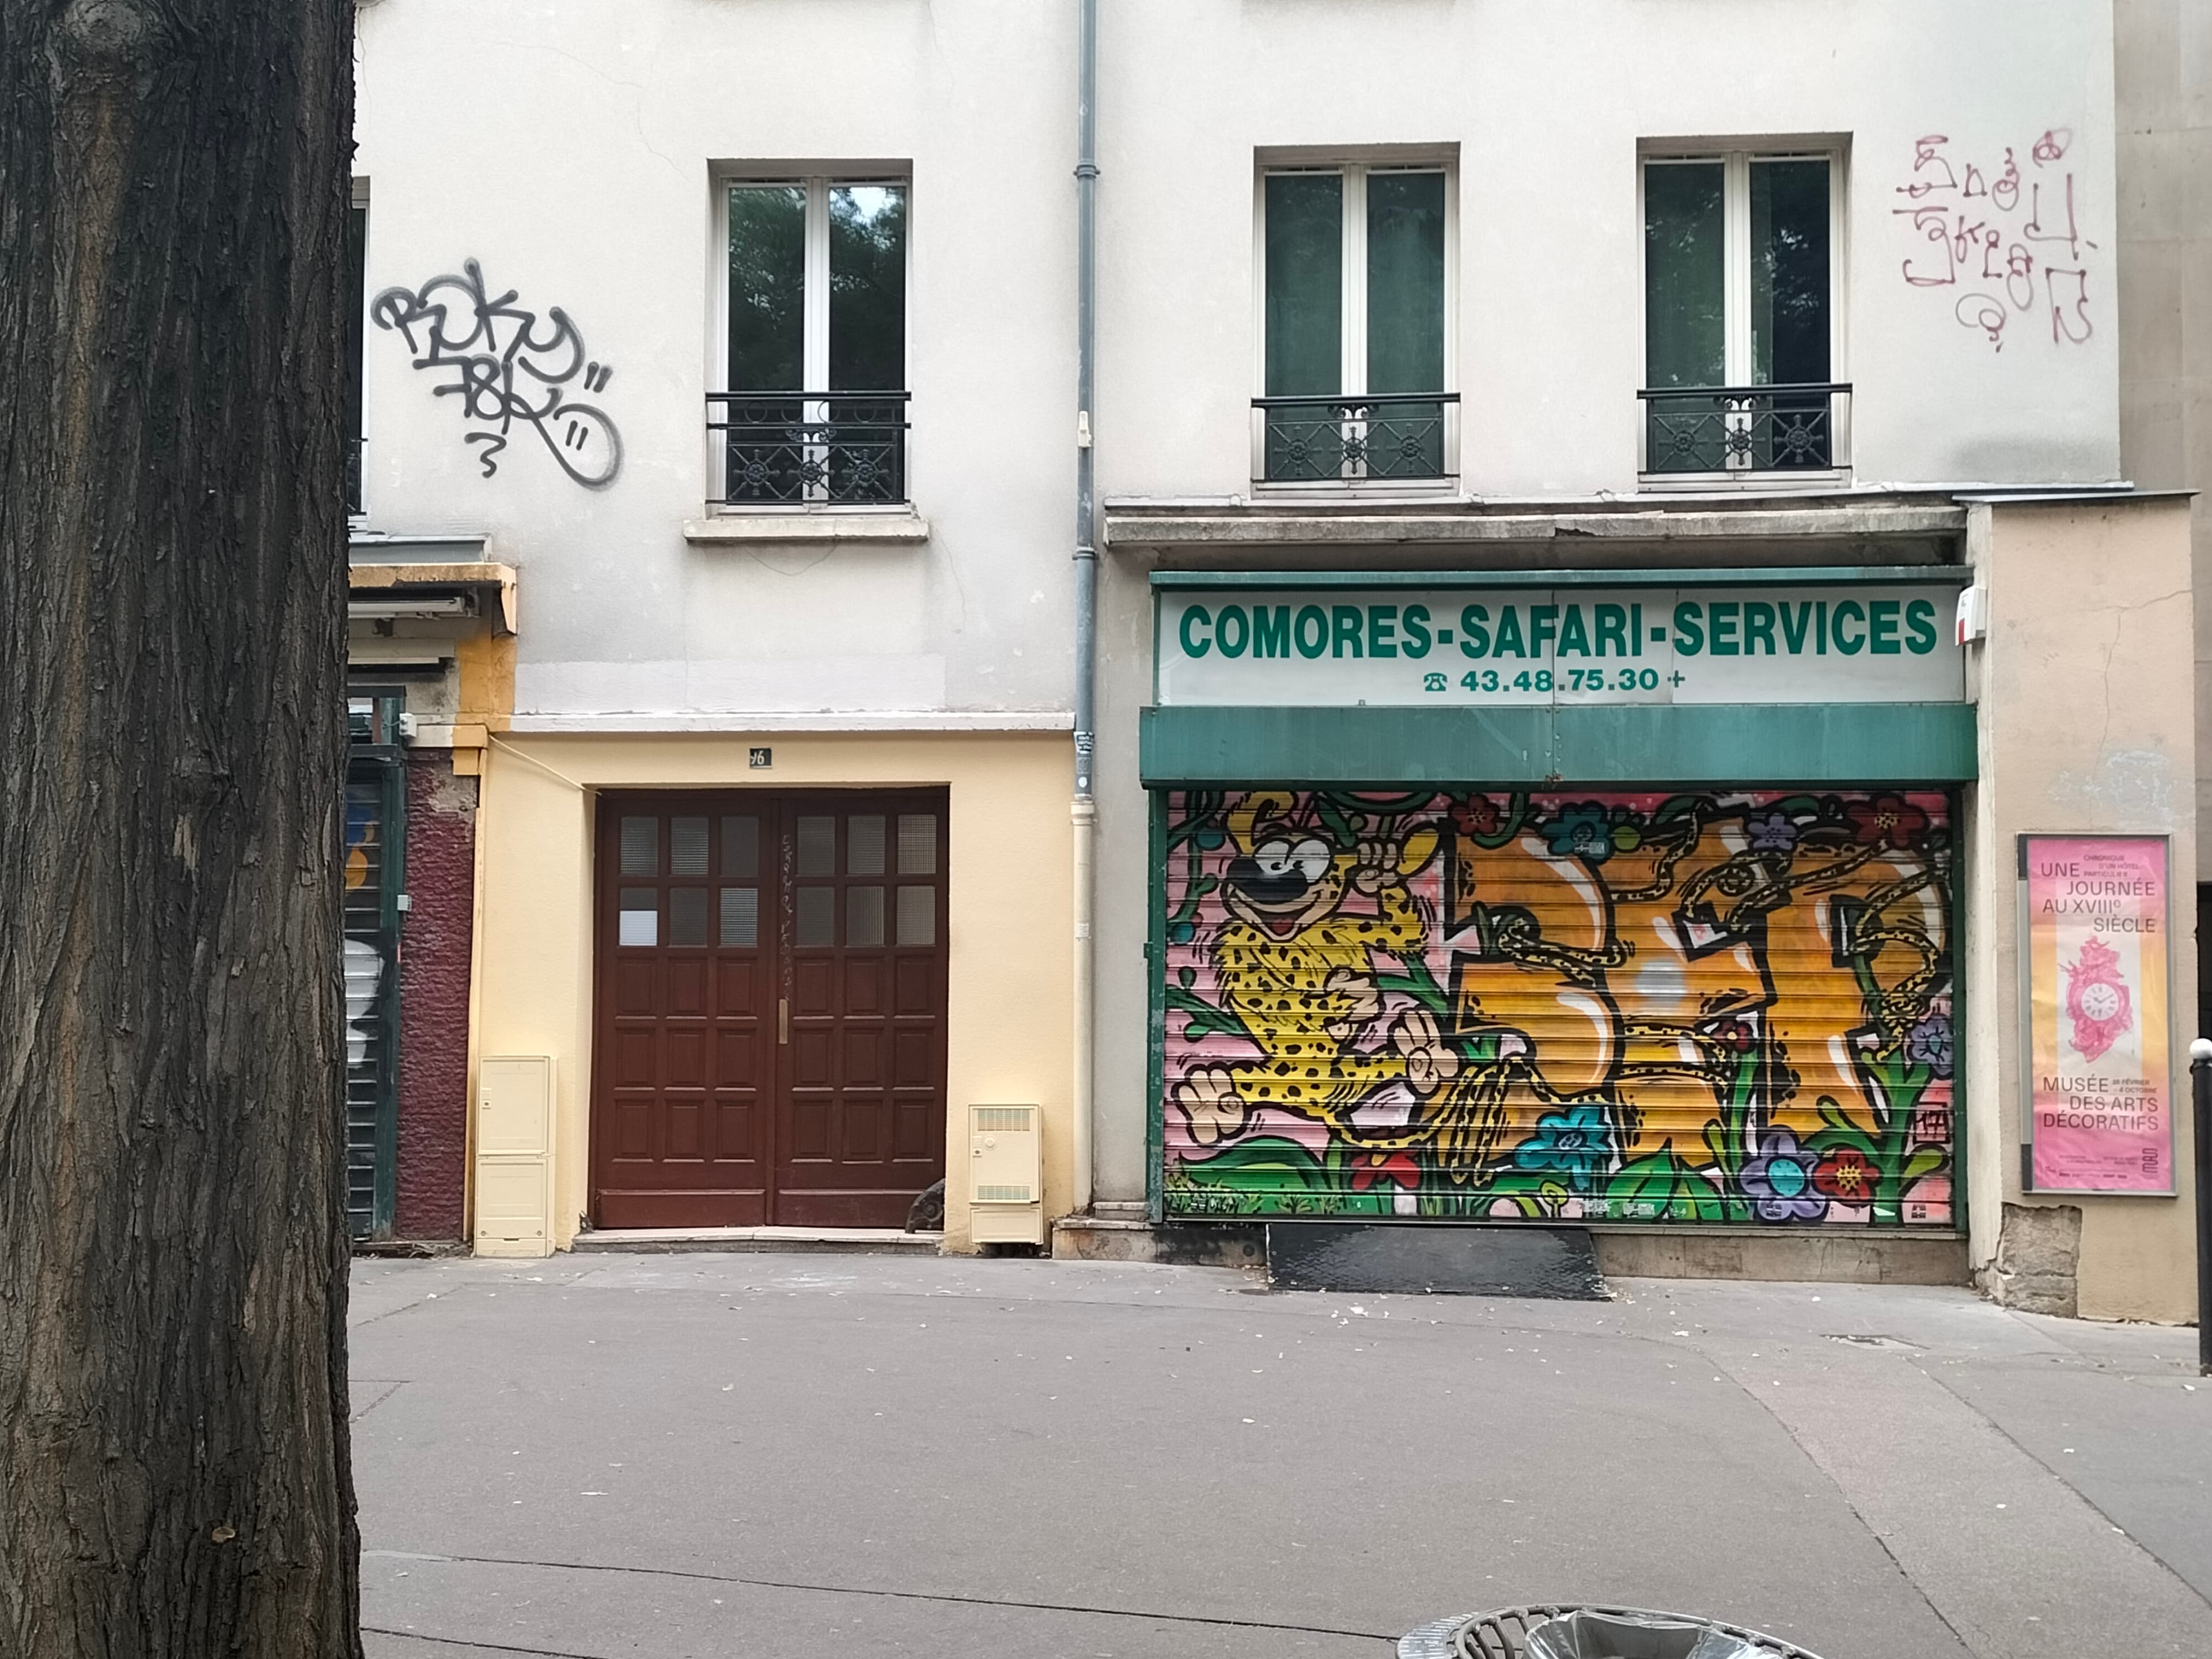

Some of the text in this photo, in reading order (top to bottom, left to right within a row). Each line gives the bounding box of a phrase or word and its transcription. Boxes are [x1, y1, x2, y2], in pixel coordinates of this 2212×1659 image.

[1460, 668, 1660, 692] 43.48.75.30
[2041, 862, 2080, 877] UNE
[2066, 877, 2156, 896] JOURNÉE
[2043, 899, 2067, 914] AU
[2093, 914, 2156, 933] SIÈCLE
[2043, 1074, 2109, 1093] MUSÉE
[2070, 1096, 2159, 1113] DES ARTS
[2043, 1109, 2159, 1131] DÉCORATIFS
